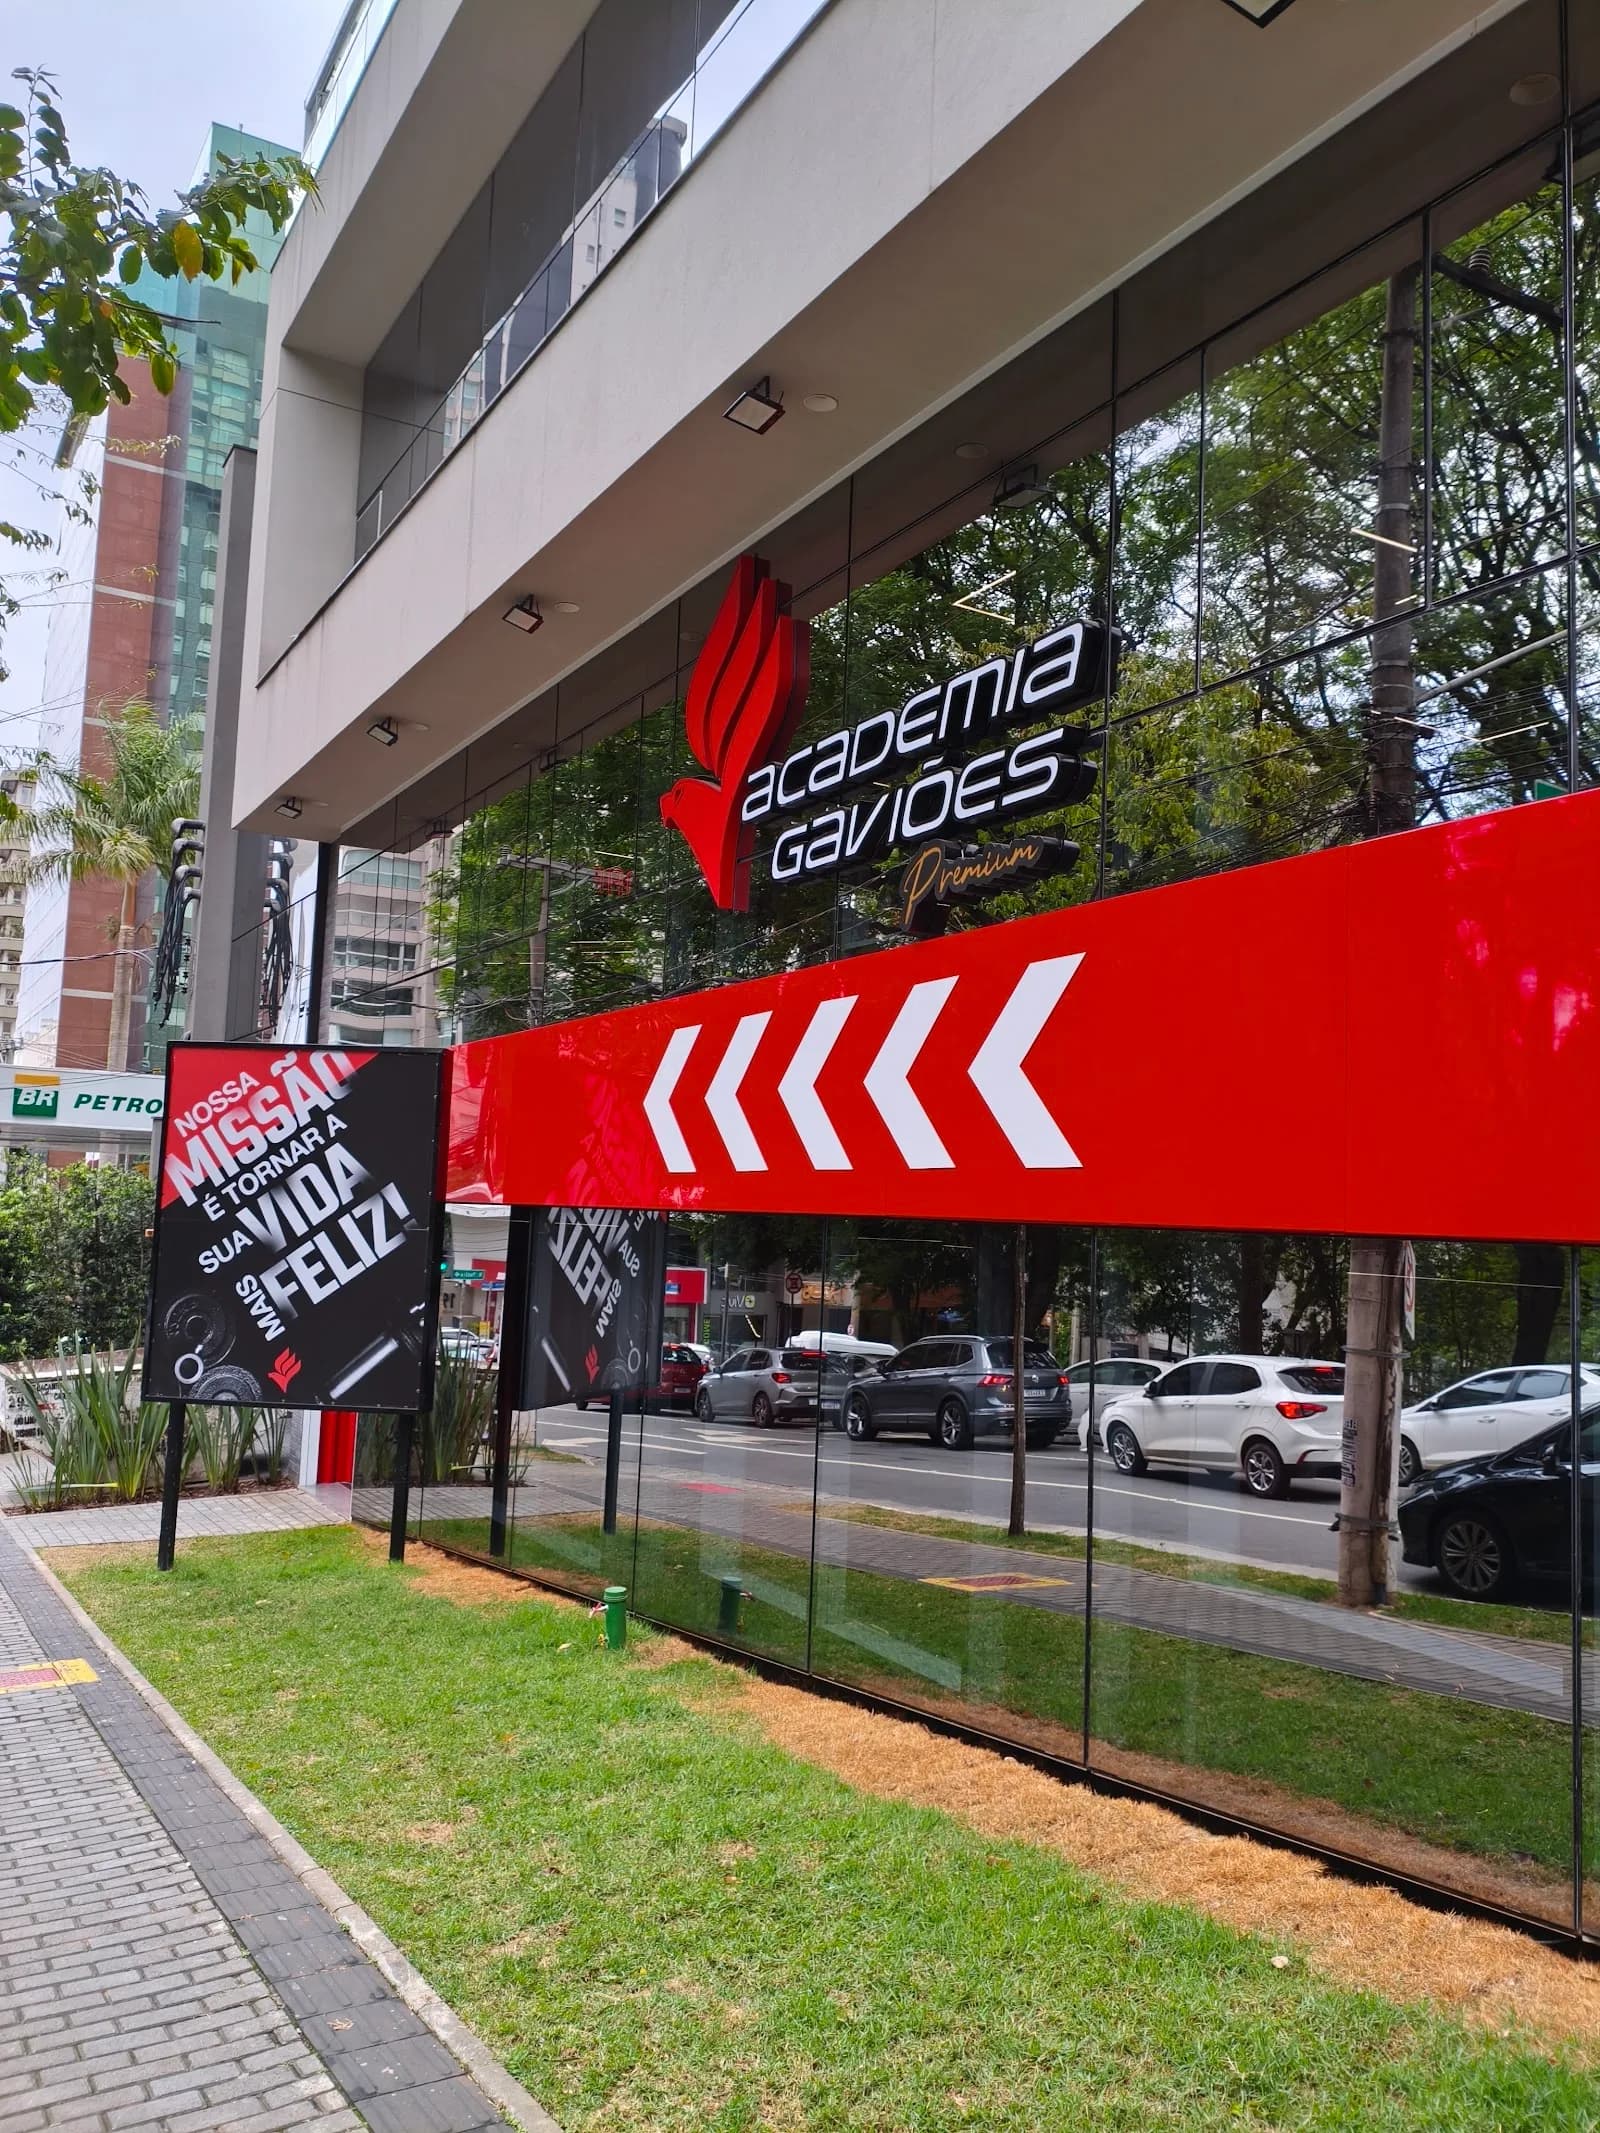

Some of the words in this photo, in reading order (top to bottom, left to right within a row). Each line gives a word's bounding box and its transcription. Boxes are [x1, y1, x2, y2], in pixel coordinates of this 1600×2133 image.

[903, 843, 1040, 925] Premium
[17, 1087, 55, 1106] BR
[73, 1093, 163, 1114] PETRO
[164, 1050, 355, 1207] MISSÃO
[174, 1071, 260, 1138] NOSSA
[198, 1229, 253, 1275] SUA
[235, 1142, 372, 1252] VIDA
[202, 1193, 226, 1222] É
[221, 1127, 325, 1205] TORNAR
[326, 1113, 348, 1138] A
[259, 1182, 418, 1320] FELIZ!
[236, 1274, 286, 1342] MAIS
